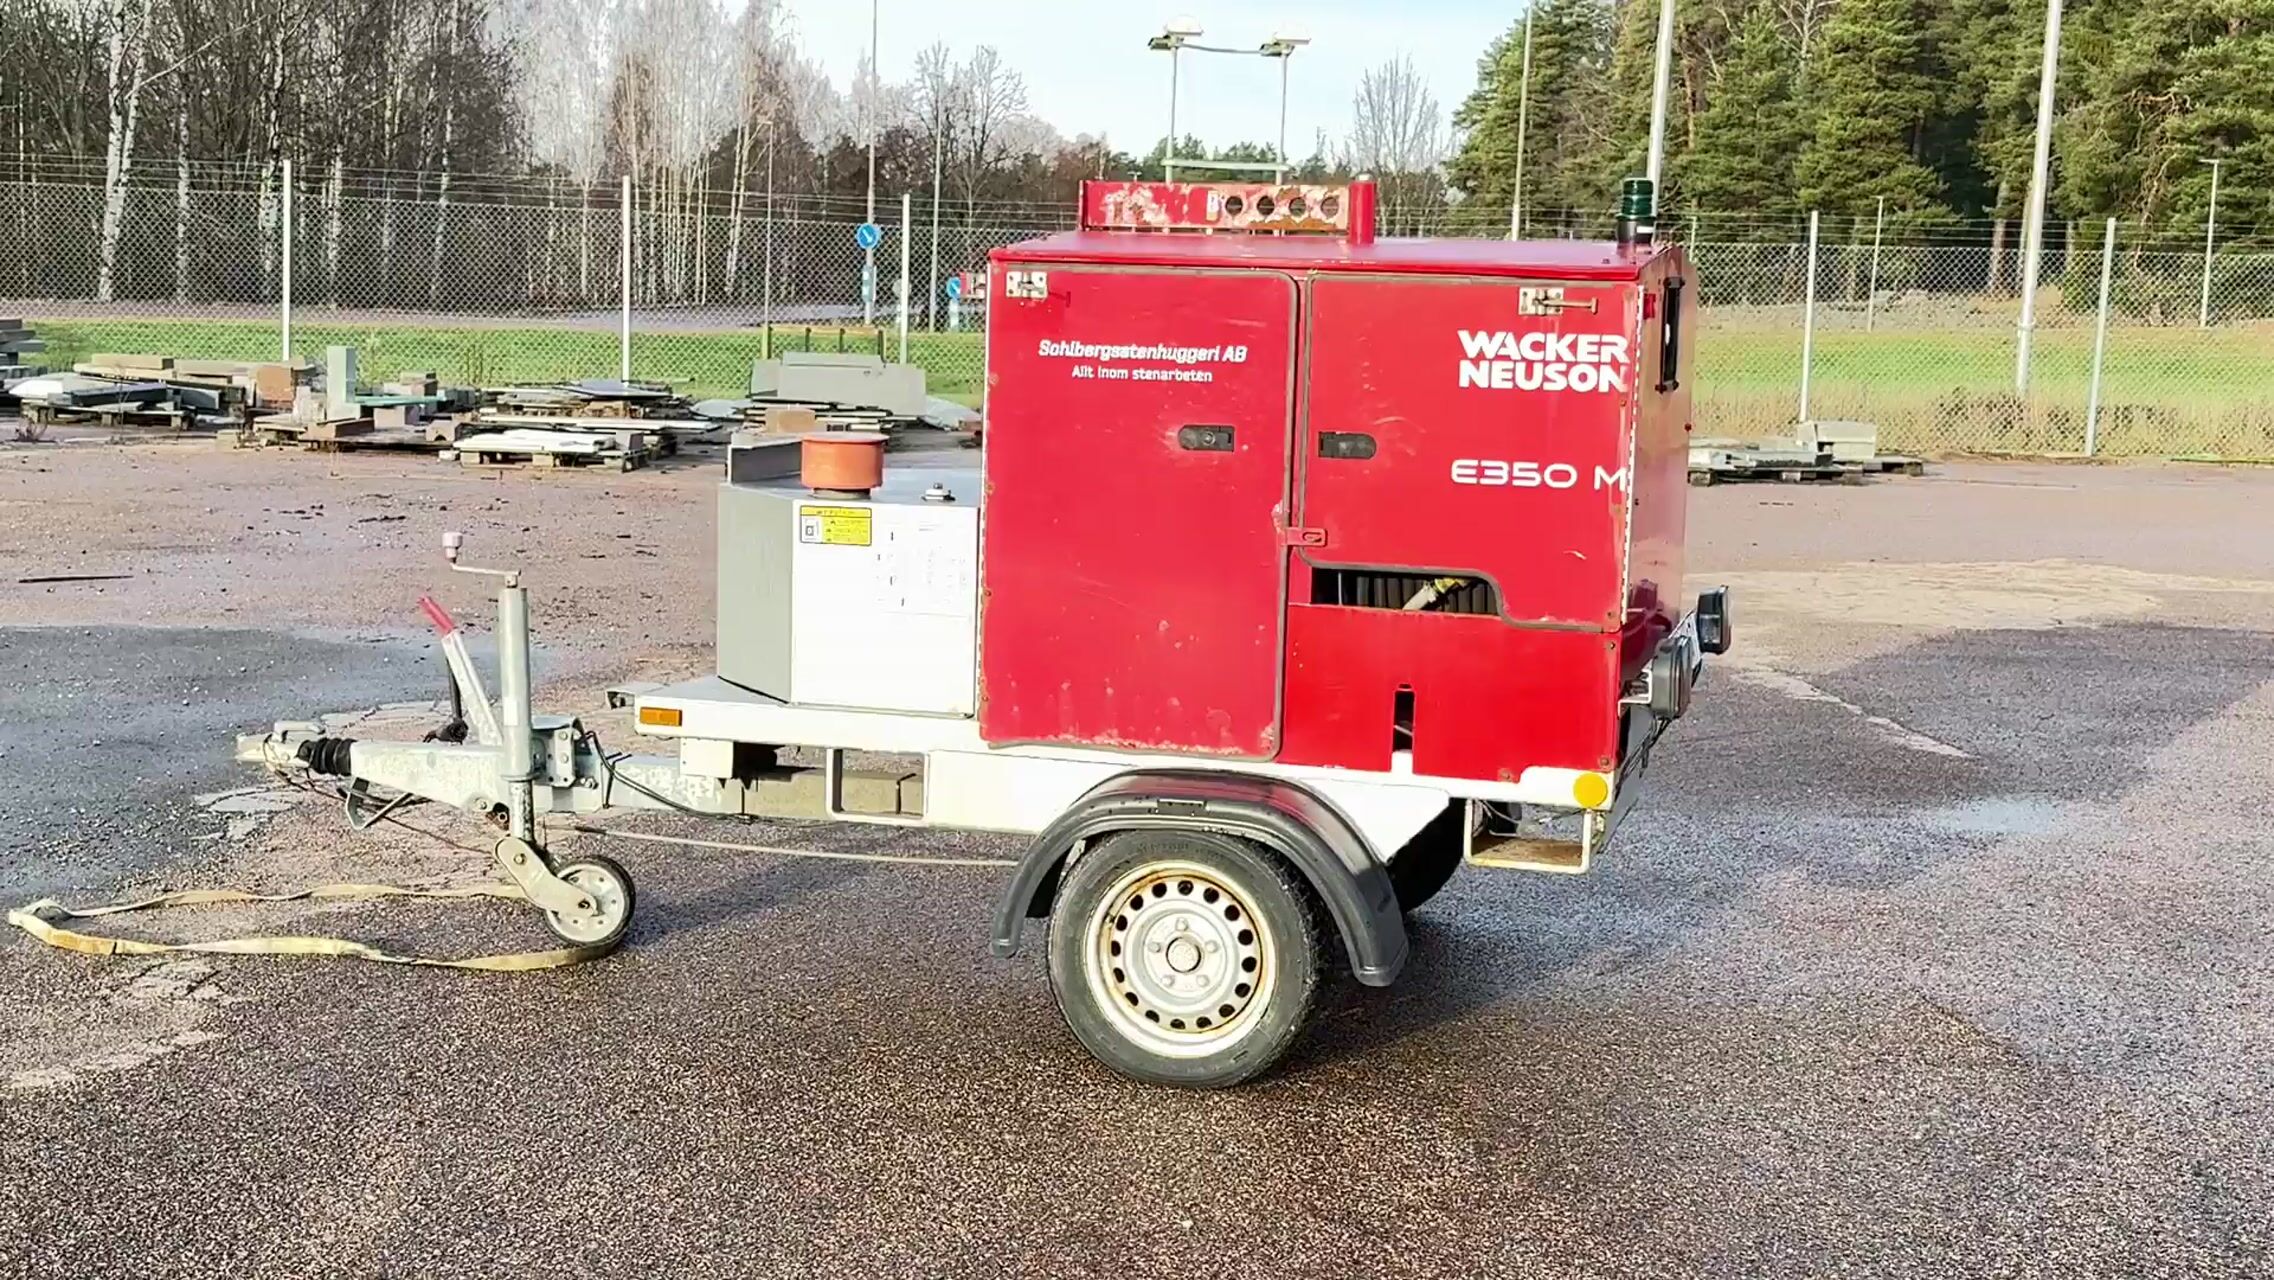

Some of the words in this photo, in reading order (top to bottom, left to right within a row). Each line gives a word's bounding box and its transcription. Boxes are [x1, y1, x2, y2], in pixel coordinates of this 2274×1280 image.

[1221, 344, 1248, 362] AB
[1457, 330, 1630, 364] WACKER
[1072, 365, 1095, 378] Allt
[1132, 368, 1213, 382] stenarbeten
[1458, 360, 1628, 393] NEUSON
[1451, 459, 1578, 489] E350
[1593, 465, 1627, 492] M
